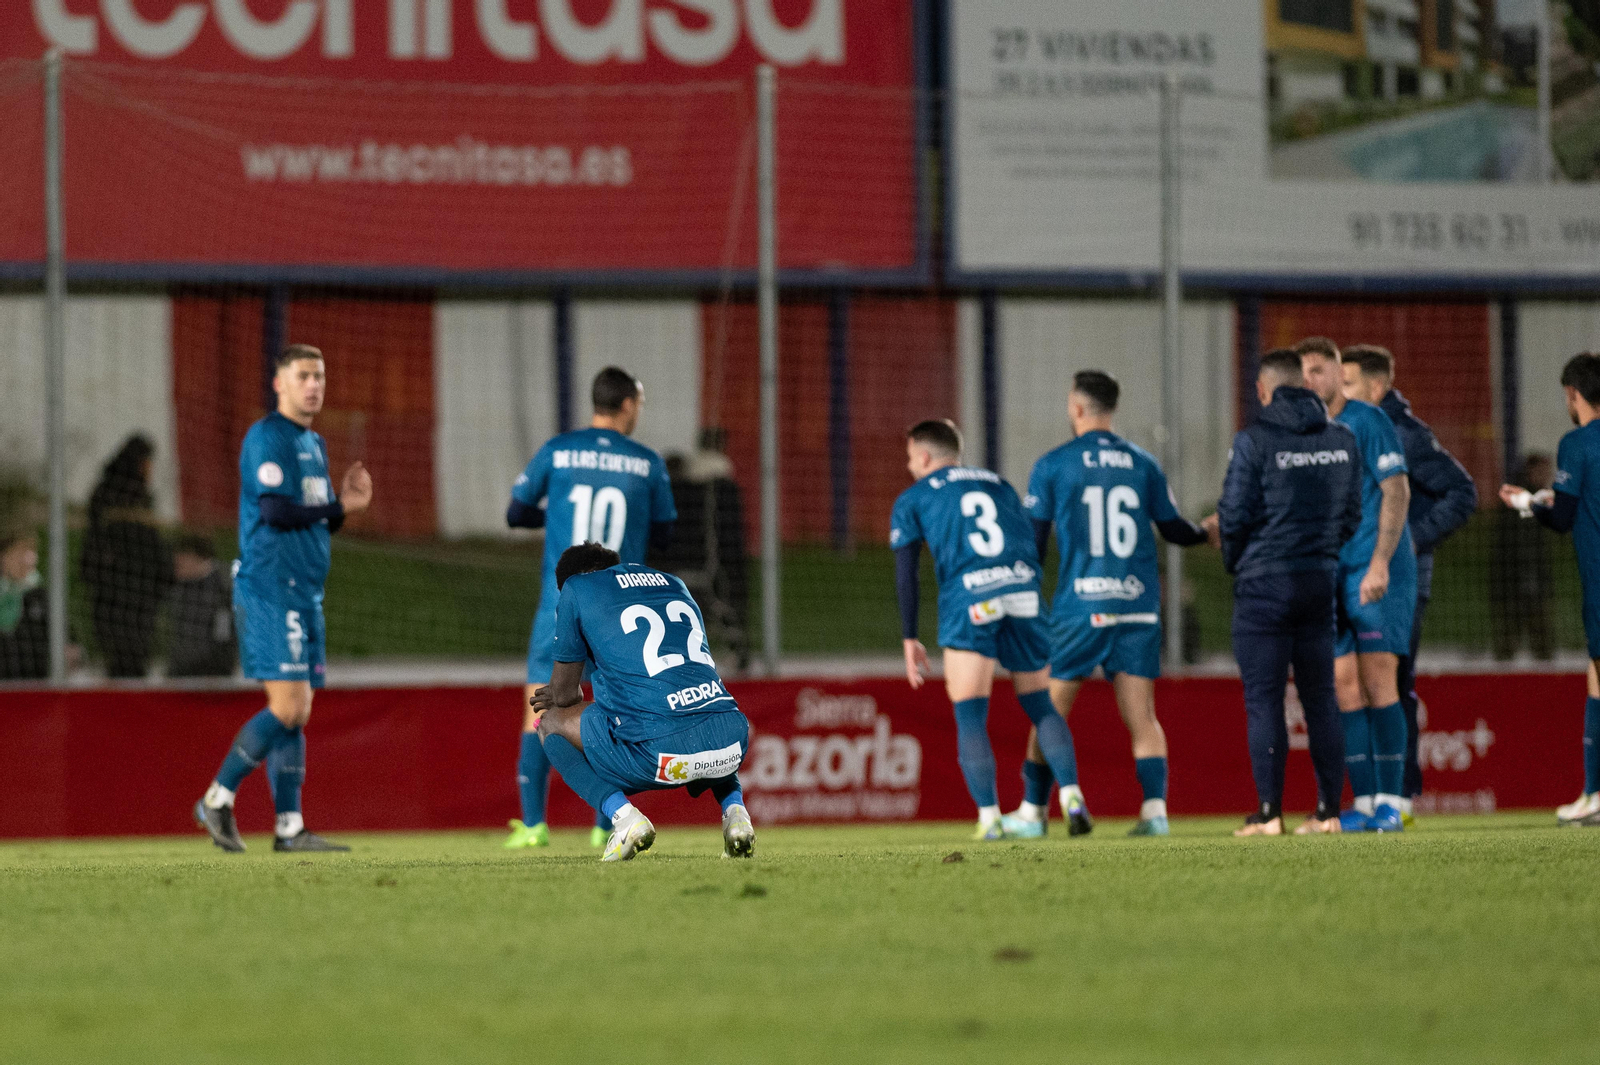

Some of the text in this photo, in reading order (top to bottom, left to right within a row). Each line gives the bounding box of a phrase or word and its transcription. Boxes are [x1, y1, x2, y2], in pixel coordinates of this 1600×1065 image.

[242, 135, 632, 187] www.tecnitasa.es
[599, 452, 651, 477] CUEVAS
[567, 483, 627, 553] 10
[960, 491, 1005, 557] 3
[1081, 485, 1140, 558] 16
[615, 572, 669, 589] DIARRA
[286, 610, 303, 640] 5
[620, 600, 715, 677] 22
[796, 688, 877, 728] Sierra
[694, 753, 740, 771] Diputación
[739, 714, 922, 789] azorla
[691, 771, 703, 779] de
